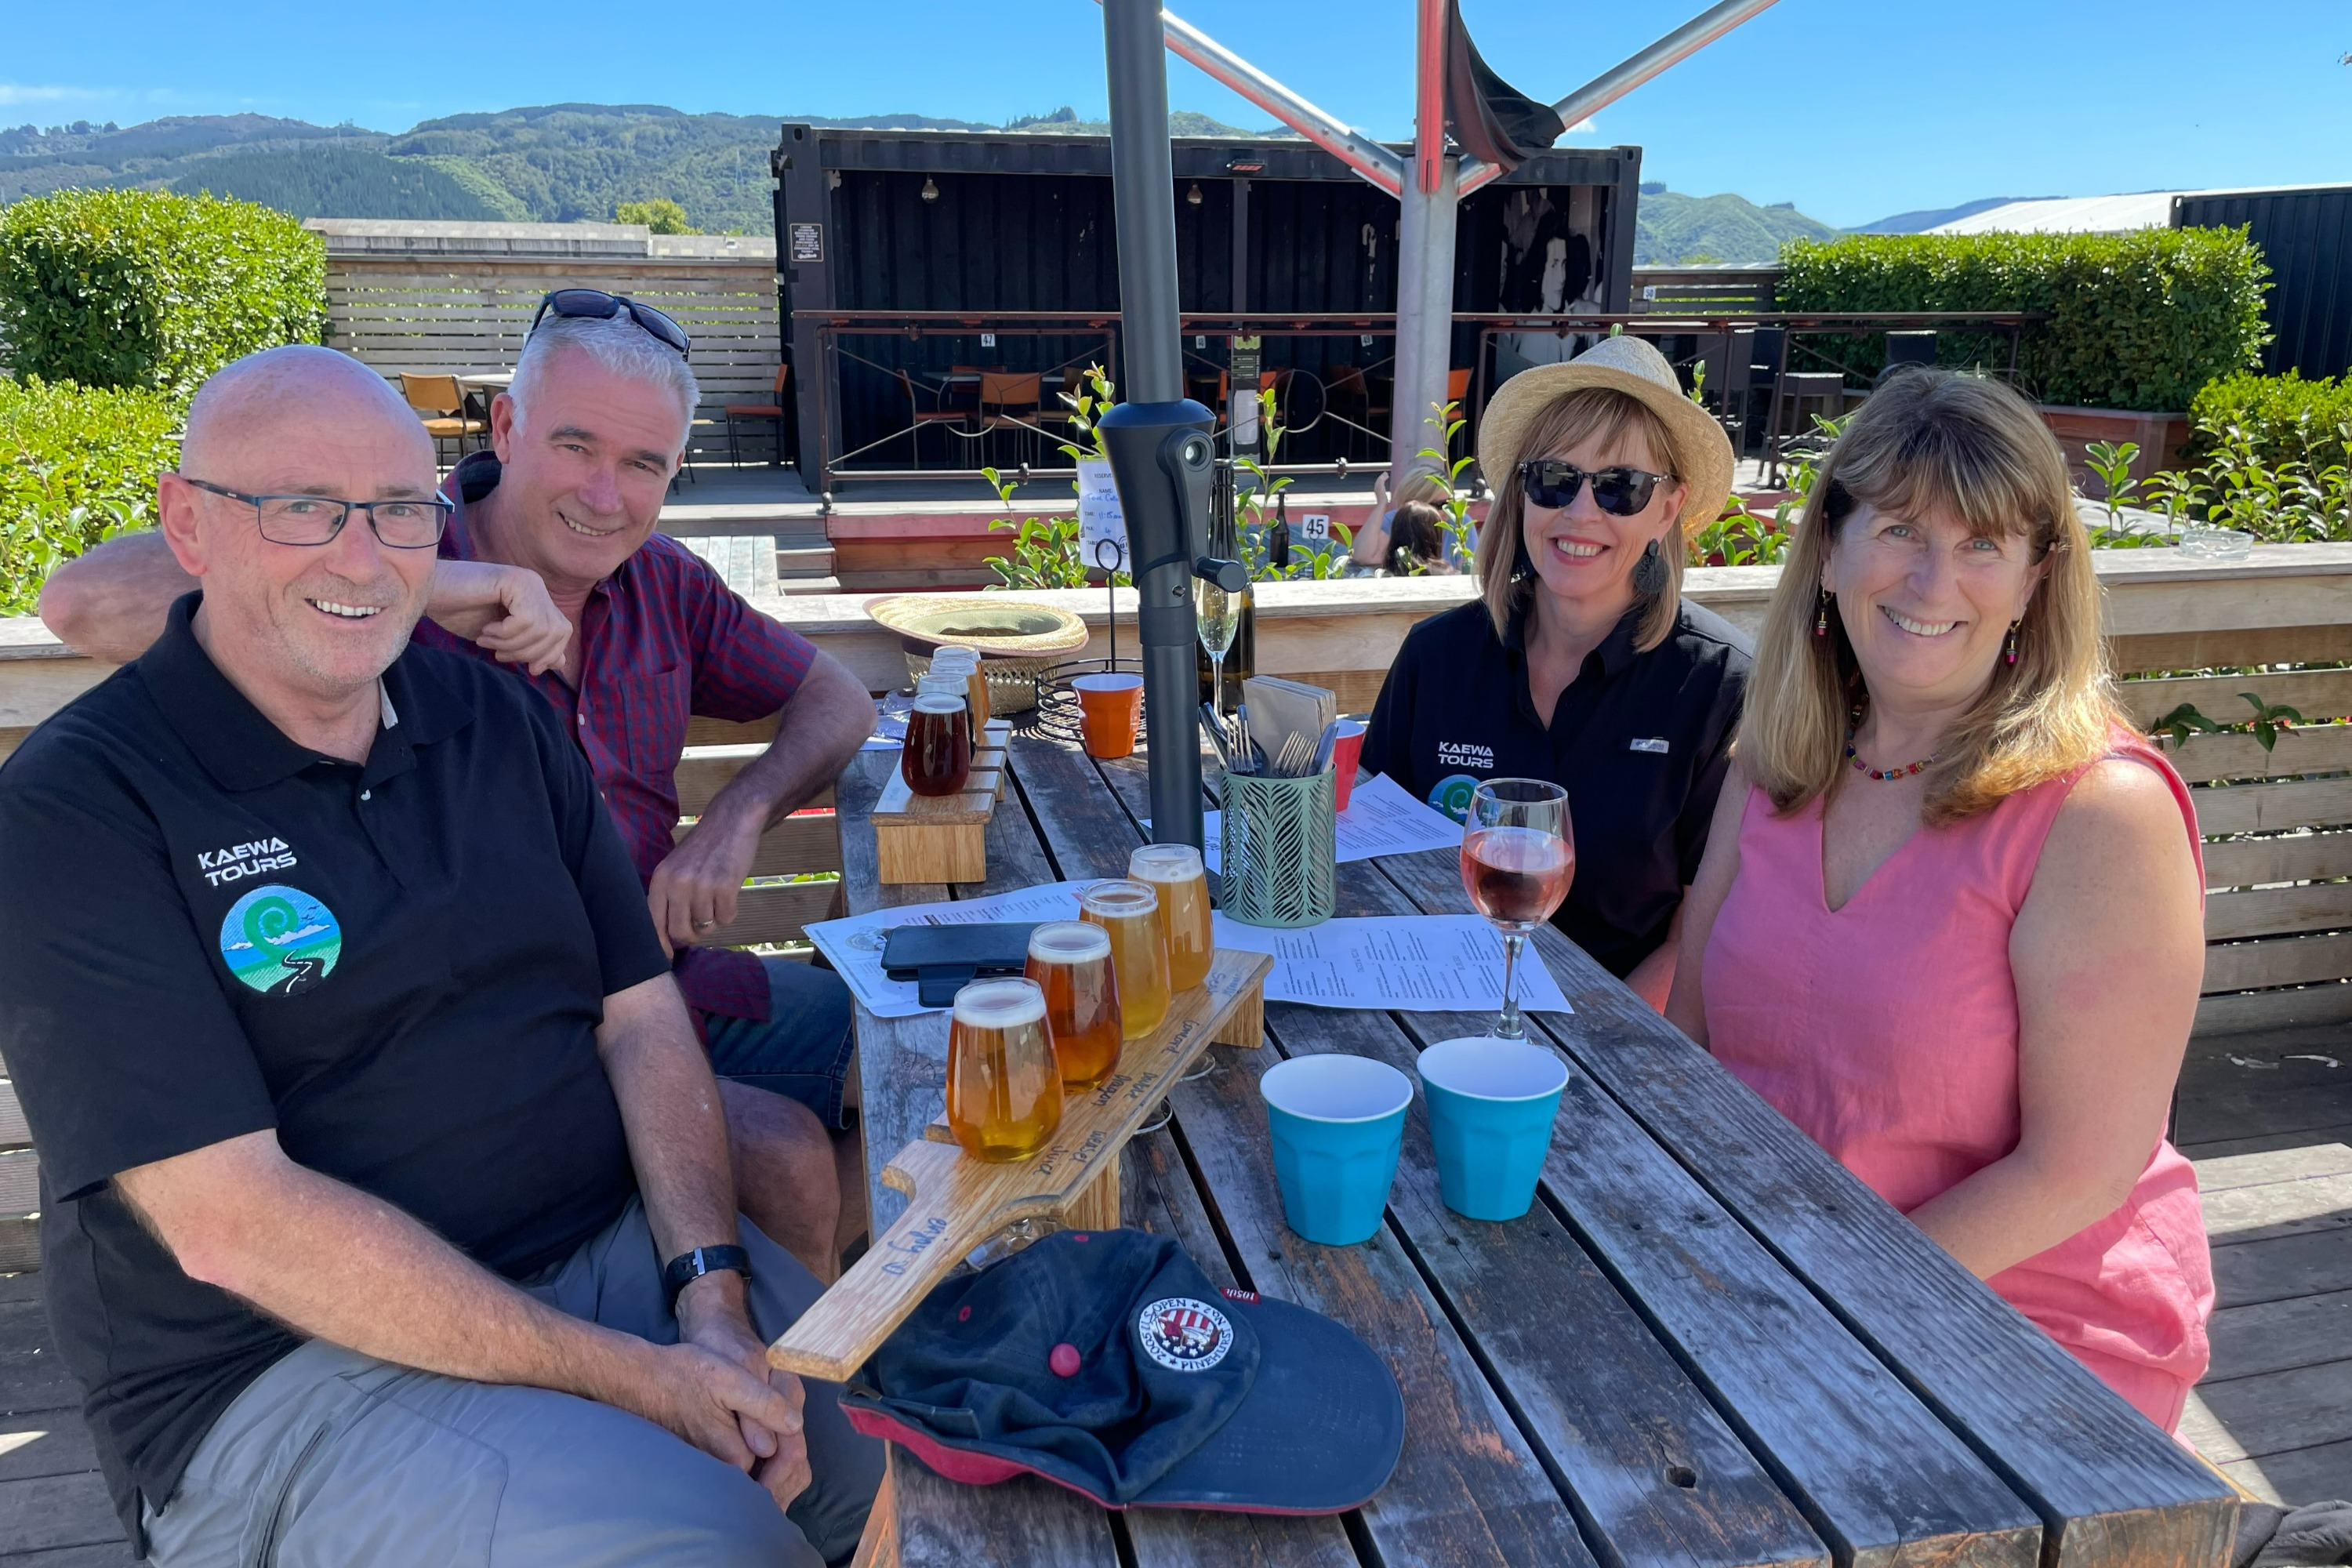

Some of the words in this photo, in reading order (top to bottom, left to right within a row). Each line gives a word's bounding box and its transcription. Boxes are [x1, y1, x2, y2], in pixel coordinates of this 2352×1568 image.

[982, 335, 993, 345] 47
[1306, 518, 1324, 535] 45
[1439, 741, 1494, 757] KAEWA
[1438, 753, 1494, 769] TOURS
[198, 837, 289, 869] KAEWA
[205, 851, 297, 887] TOURS
[1226, 1288, 1255, 1301] 105th
[1152, 1299, 1186, 1312] OPEN
[1142, 1334, 1167, 1360] 2005
[1181, 1329, 1231, 1370] PINEHURST
